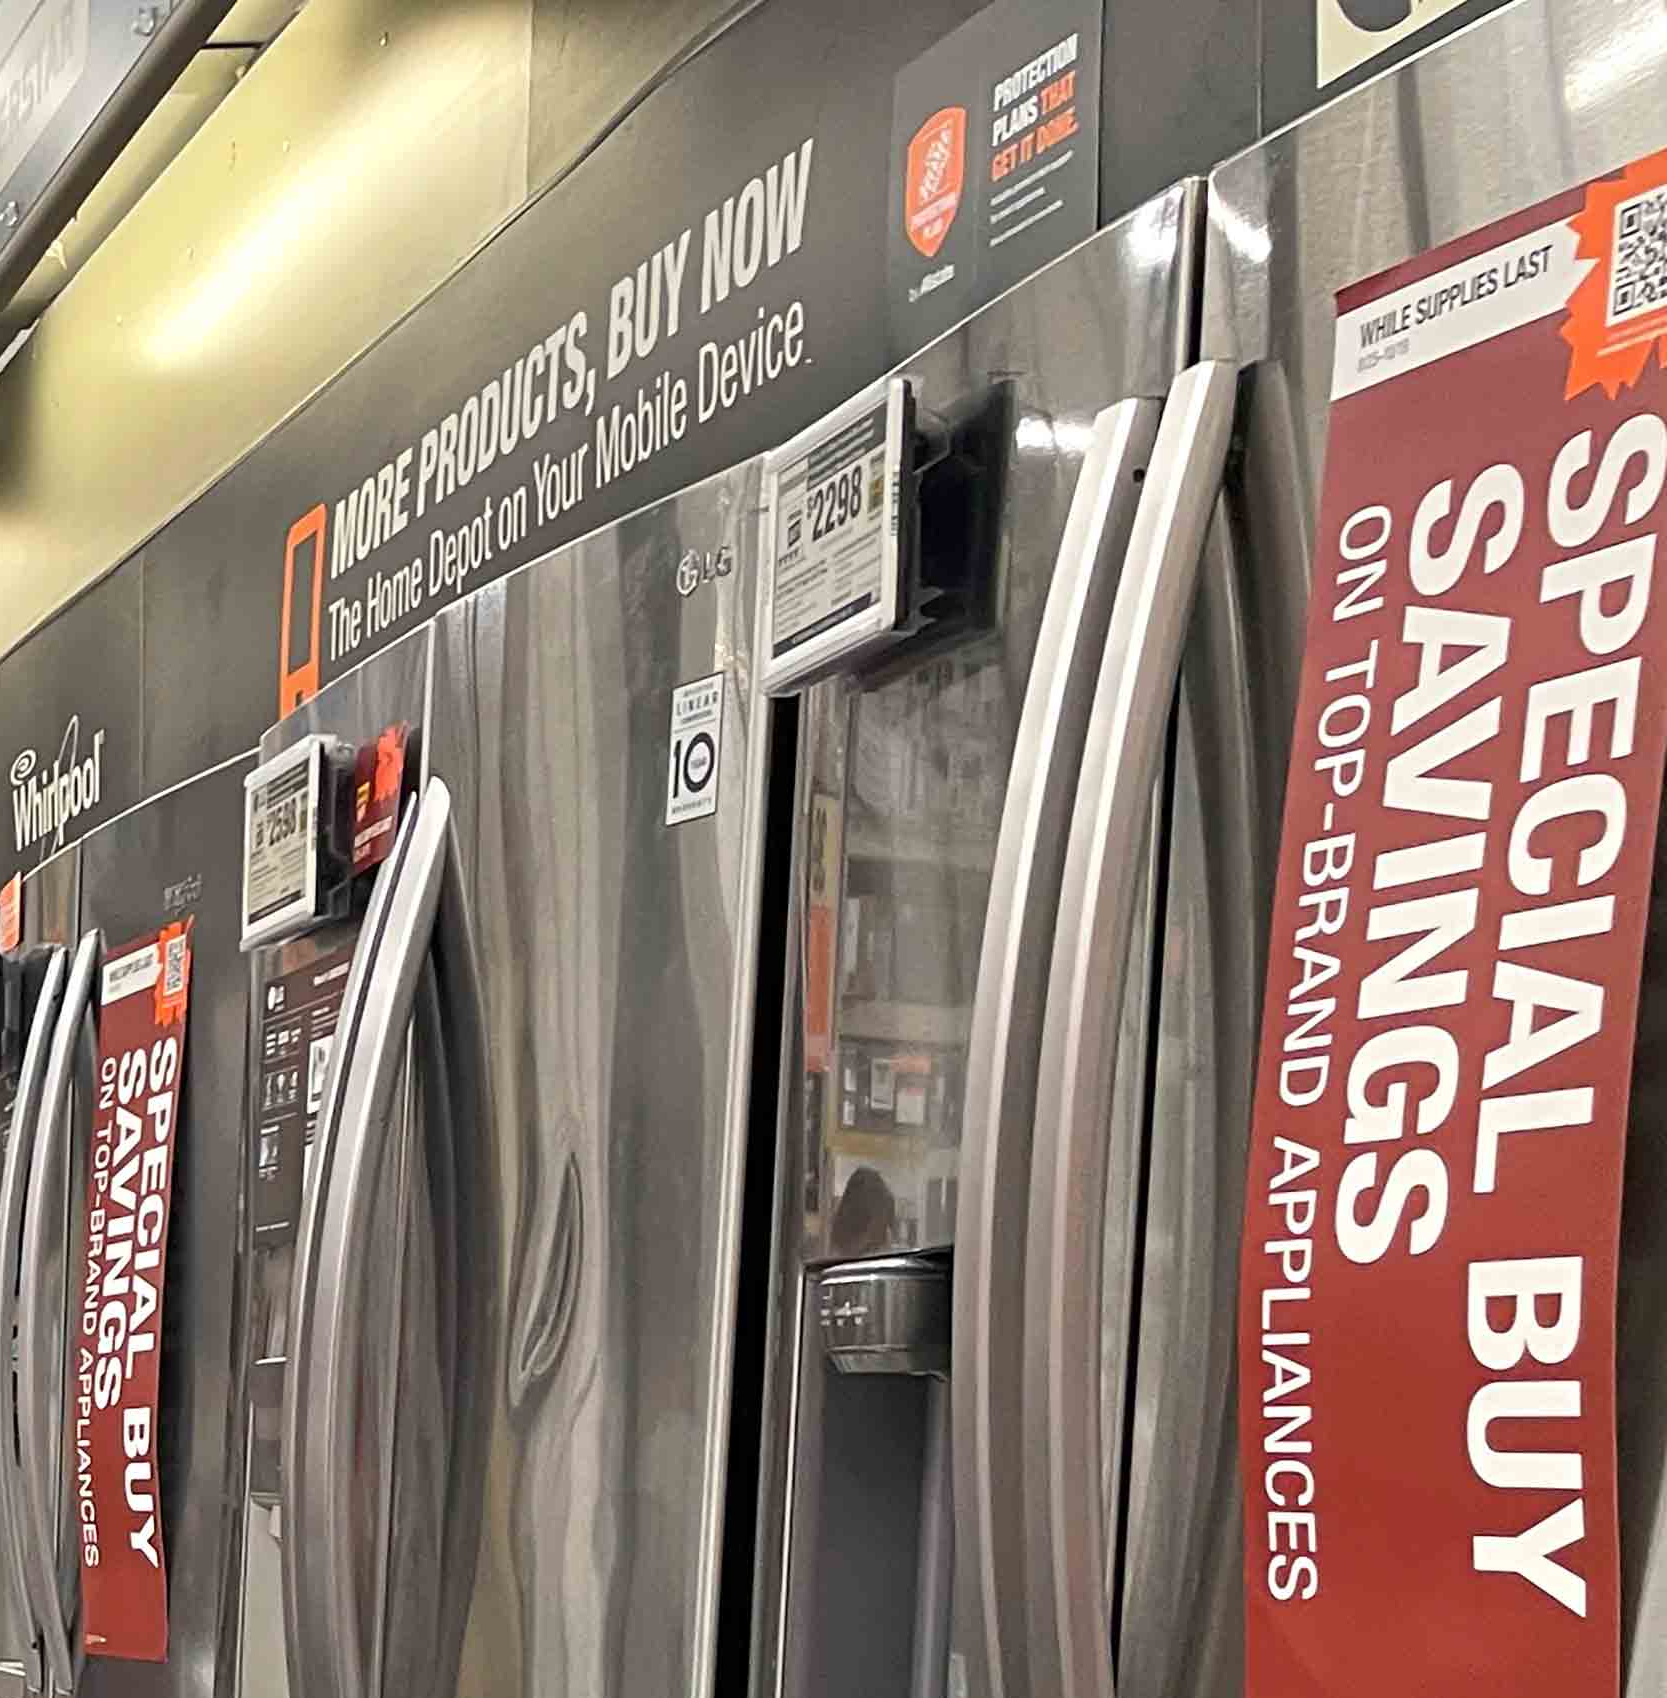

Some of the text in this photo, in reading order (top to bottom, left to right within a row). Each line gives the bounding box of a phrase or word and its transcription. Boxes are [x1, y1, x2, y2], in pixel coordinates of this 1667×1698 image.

[992, 70, 1075, 147] PLANS THAT
[993, 33, 1078, 112] PROTECTION
[330, 138, 814, 580] MORE PRODUCTS, BUY NOW
[1360, 244, 1553, 348] WHILE SUPPLIES LAST
[329, 597, 361, 661] The
[366, 561, 423, 640] Home
[429, 496, 492, 602] Depot
[498, 490, 527, 551] on
[532, 444, 588, 524] Your
[595, 370, 687, 489] Mobile
[699, 545, 733, 584] LG
[806, 464, 862, 543] $2298
[11, 715, 105, 852] Whirlpool
[673, 732, 715, 799] 10
[1334, 463, 1525, 1266] SAVINGS
[1260, 504, 1392, 1602] ON TOP-BRAND APPLIANCES
[1467, 414, 1667, 1618] SPECIAL BUY
[77, 1057, 117, 1568] ON TOP-BRAND APPLIANCES
[94, 1050, 146, 1412] SAVINGS
[123, 1037, 178, 1380] SPECIAL
[123, 1406, 160, 1568] BUY
